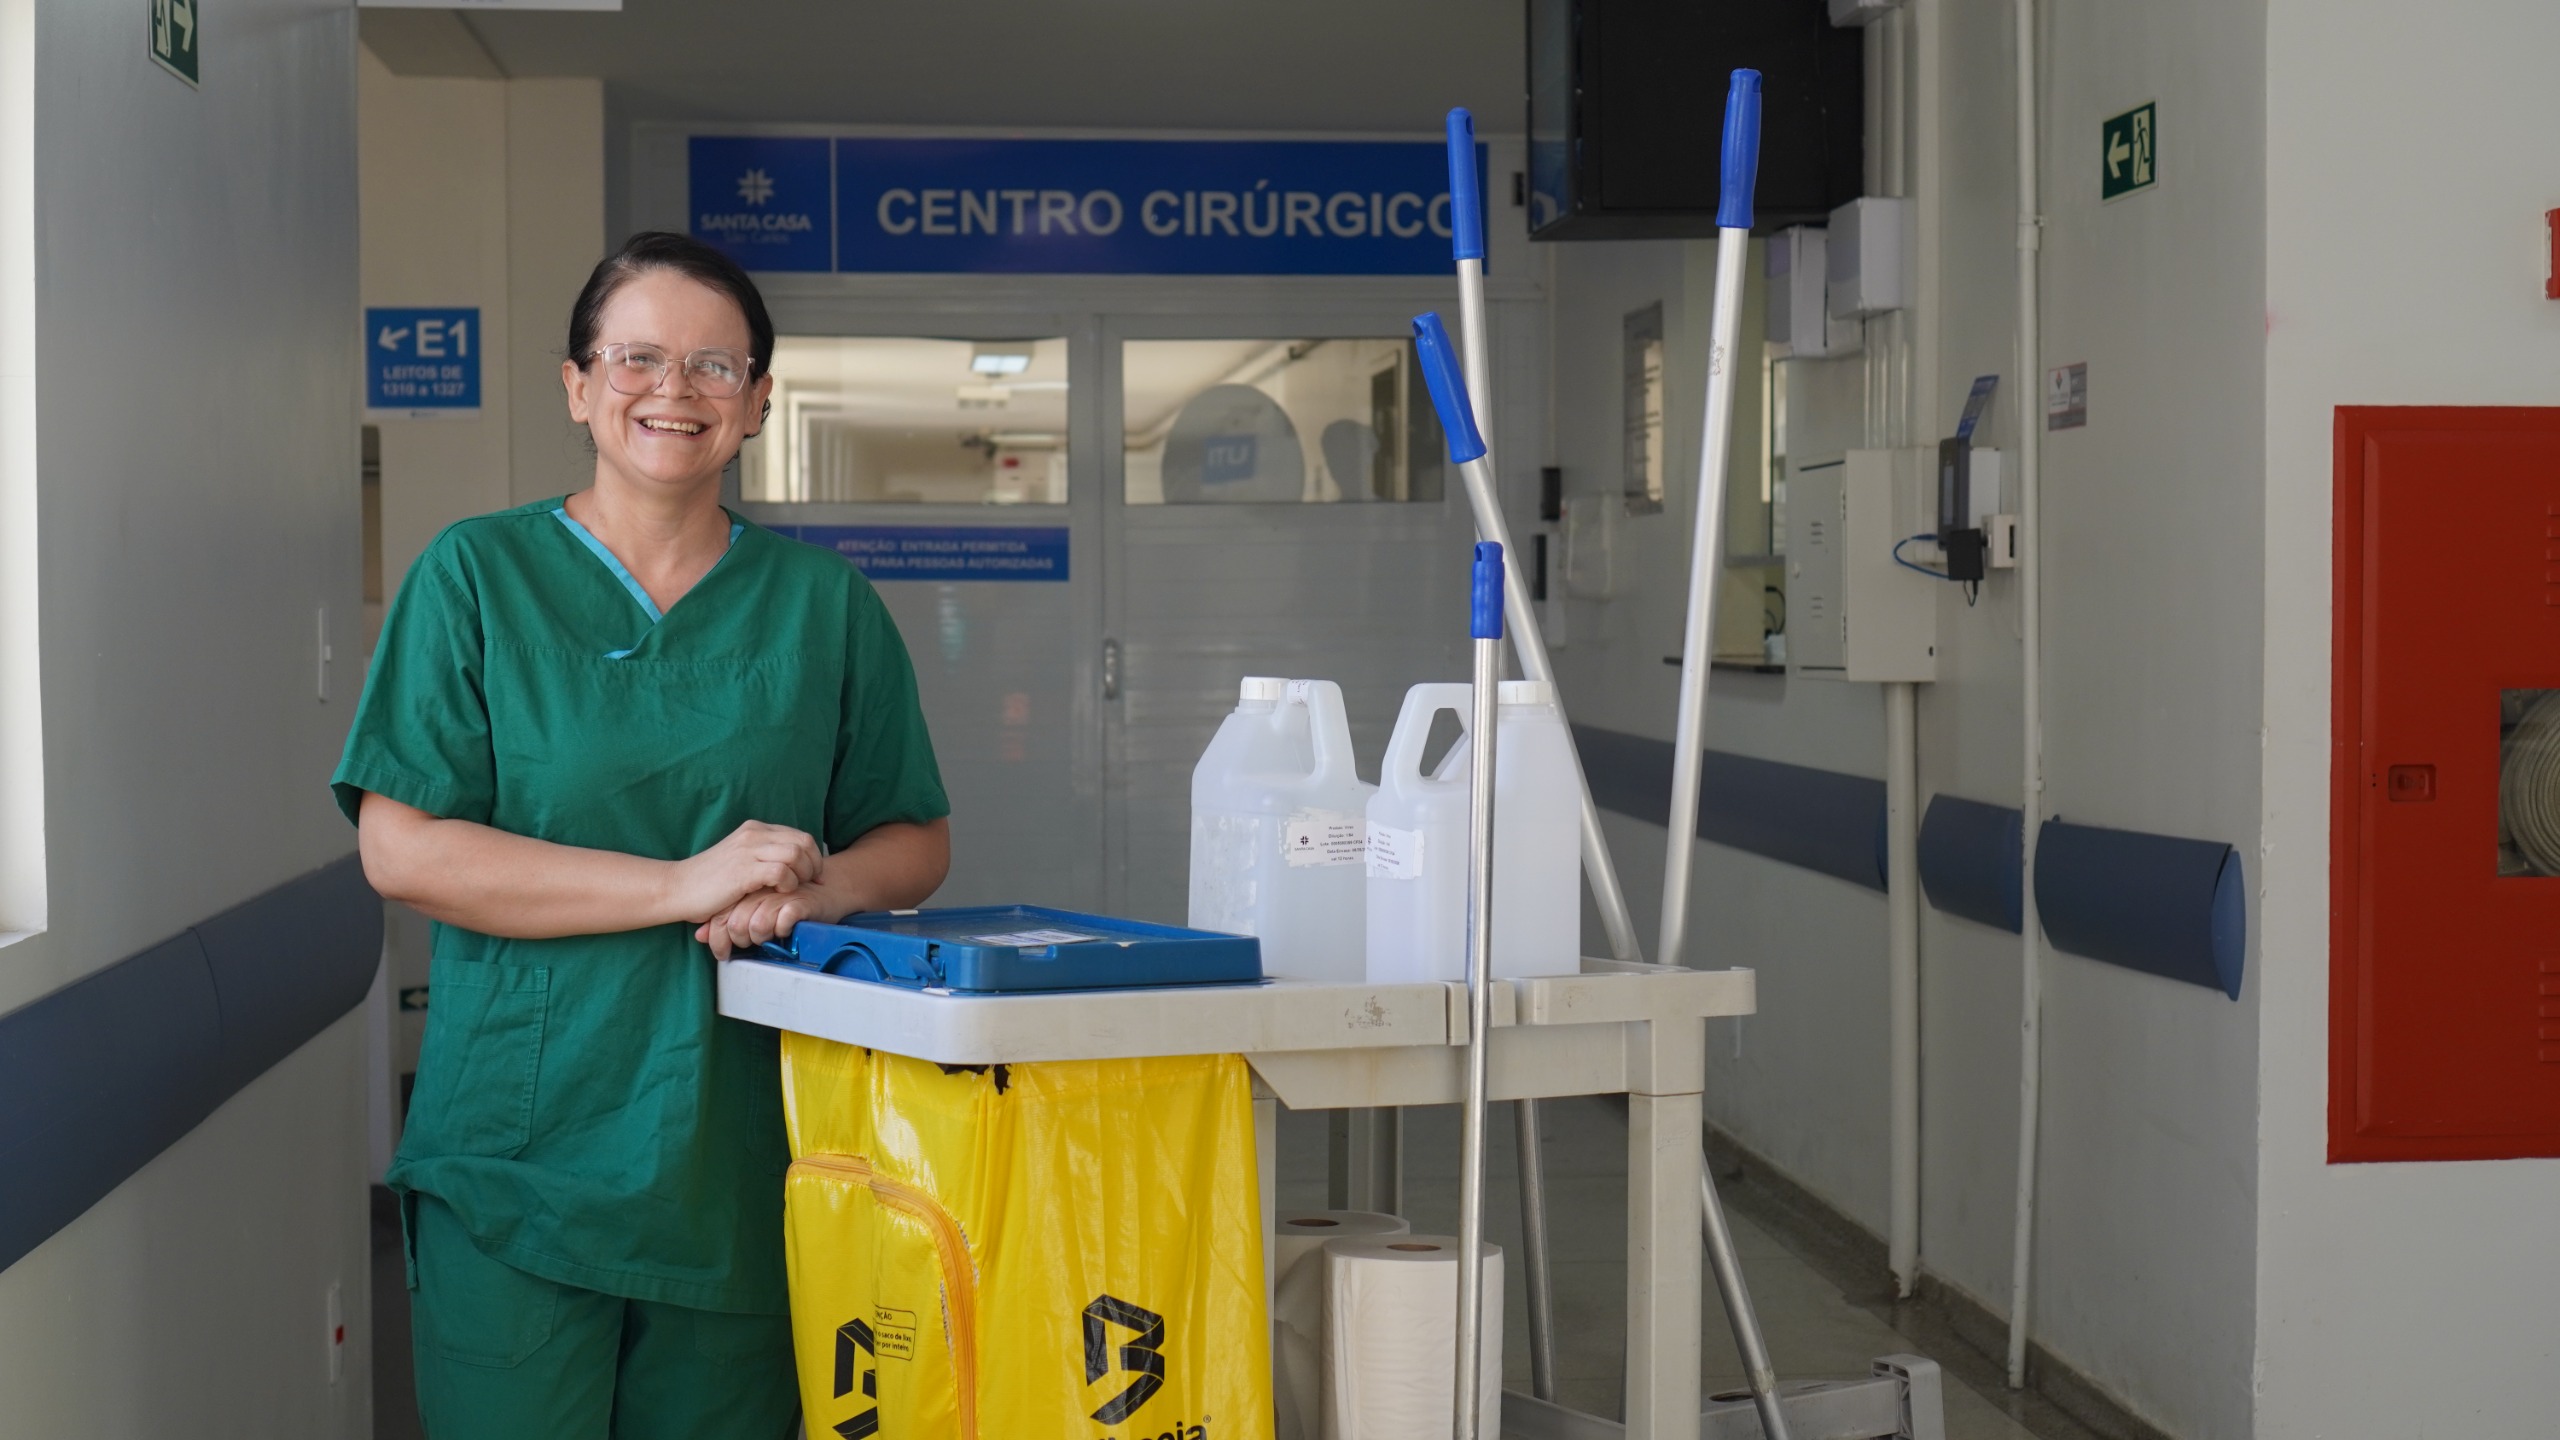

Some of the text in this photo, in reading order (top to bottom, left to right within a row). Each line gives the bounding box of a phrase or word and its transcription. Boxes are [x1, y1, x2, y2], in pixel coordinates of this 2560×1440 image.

[877, 188, 1123, 236] CENTRO
[701, 213, 812, 231] SANTA CASA
[416, 319, 467, 357] E1
[383, 365, 462, 380] LEITOS DE
[901, 541, 959, 553] ENTRADA
[961, 541, 1028, 553] PERMITIDA
[872, 557, 903, 569] PARA
[907, 557, 964, 569] PESSOAS
[968, 557, 1053, 570] AUTORIZADAS
